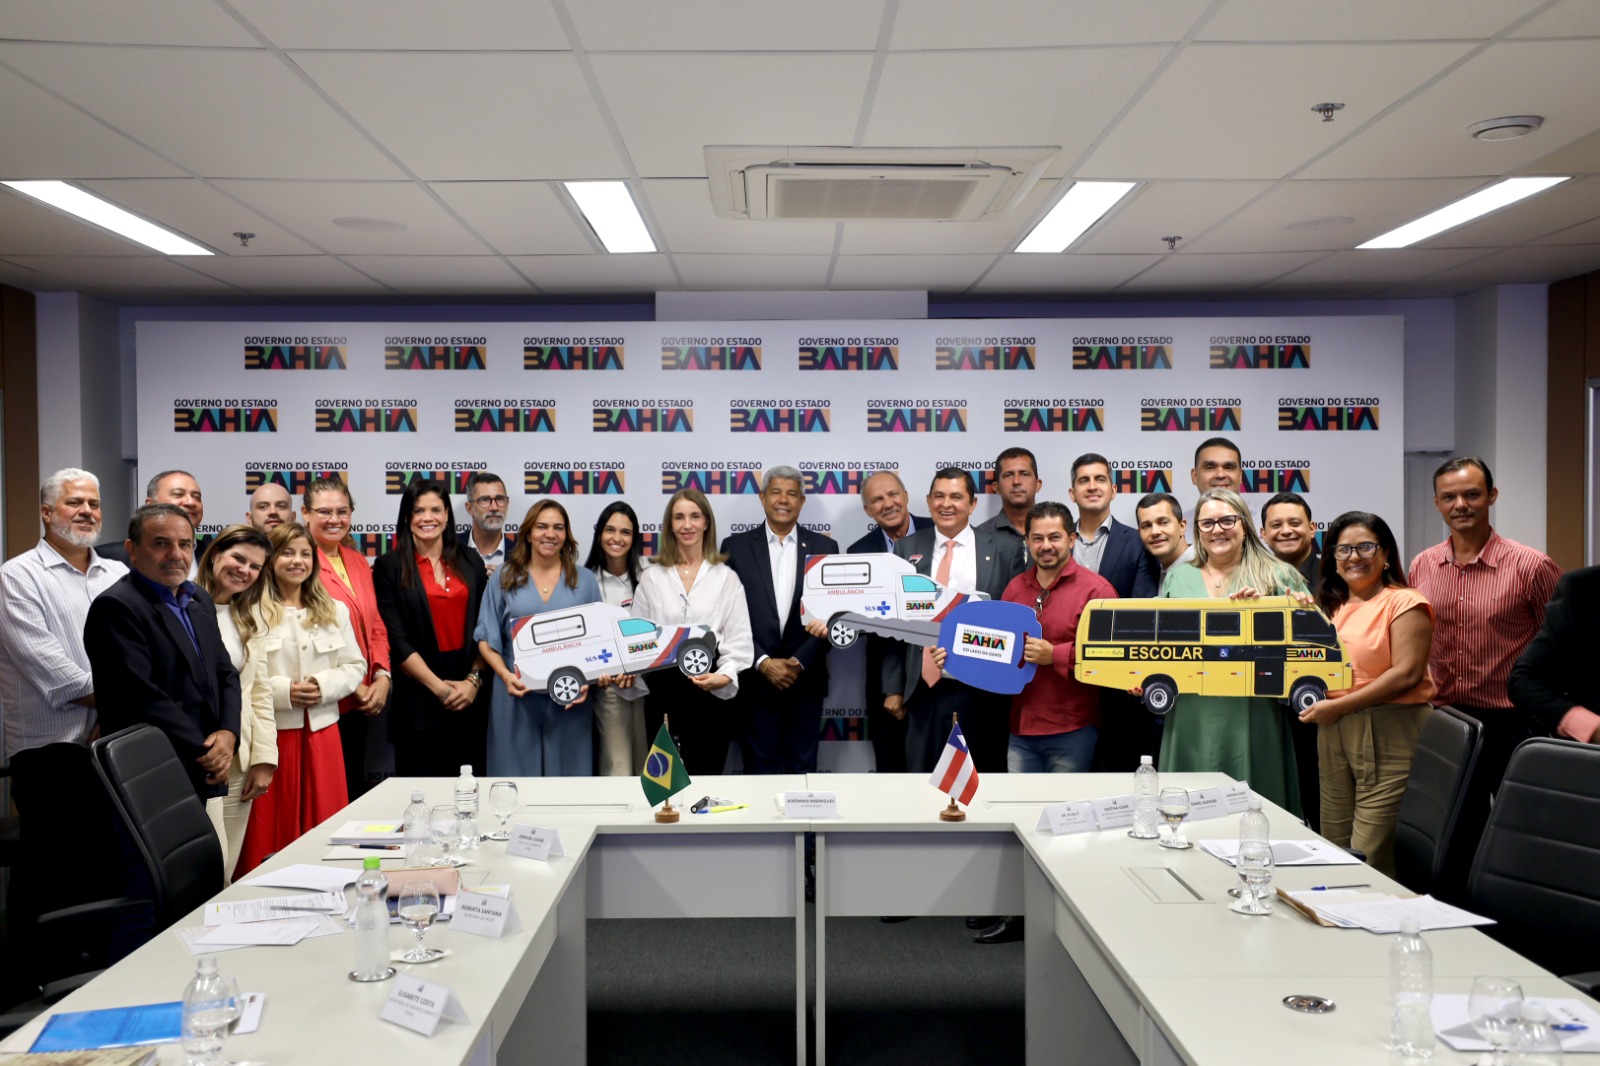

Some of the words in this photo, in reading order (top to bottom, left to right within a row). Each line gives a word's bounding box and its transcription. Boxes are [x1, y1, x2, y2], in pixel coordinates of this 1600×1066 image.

[244, 336, 293, 345] GOVERNO
[295, 336, 309, 345] DO
[311, 336, 347, 345] ESTADO
[384, 336, 433, 345] GOVERNO
[434, 336, 449, 345] DO
[450, 336, 487, 345] ESTADO
[523, 337, 571, 345] GOVERNO
[572, 337, 587, 345] DO
[589, 337, 625, 345] ESTADO
[661, 337, 708, 346] GOVERNO
[711, 337, 725, 346] DO
[727, 337, 762, 346] ESTADO
[798, 337, 846, 346] GOVERNO
[848, 337, 862, 346] DO
[864, 337, 899, 346] ESTADO
[935, 337, 982, 346] GOVERNO
[985, 337, 999, 346] DO
[1001, 337, 1036, 346] ESTADO
[1072, 336, 1119, 345] GOVERNO
[1121, 336, 1135, 345] DO
[1137, 336, 1173, 345] ESTADO
[1209, 335, 1256, 344] GOVERNO
[1258, 335, 1273, 344] DO
[1275, 335, 1311, 344] ESTADO
[244, 346, 347, 370] BAHIA
[384, 346, 487, 370] BAHIA
[523, 347, 625, 370] BAHIA
[661, 347, 762, 370] BAHIA
[798, 347, 899, 370] BAHIA
[935, 347, 1036, 370] BAHIA
[1072, 346, 1173, 370] BAHIA
[1209, 345, 1311, 369] BAHIA
[174, 399, 223, 408] GOVERNO
[225, 399, 239, 408] DO
[241, 399, 278, 408] ESTADO
[315, 399, 363, 408] GOVERNO
[365, 399, 379, 408] DO
[381, 399, 418, 408] ESTADO
[454, 399, 502, 408] GOVERNO
[503, 399, 518, 408] DO
[520, 399, 556, 408] ESTADO
[592, 399, 640, 408] GOVERNO
[642, 399, 656, 408] DO
[658, 399, 694, 408] ESTADO
[729, 399, 777, 408] GOVERNO
[779, 399, 793, 408] DO
[795, 399, 831, 408] ESTADO
[866, 399, 914, 408] GOVERNO
[916, 399, 930, 408] DO
[932, 399, 968, 408] ESTADO
[1003, 399, 1051, 408] GOVERNO
[1053, 399, 1067, 408] DO
[1069, 399, 1105, 408] ESTADO
[1140, 398, 1188, 407] GOVERNO
[1190, 398, 1204, 407] DO
[1206, 398, 1242, 407] ESTADO
[1278, 398, 1326, 407] GOVERNO
[1327, 398, 1342, 407] DO
[1343, 398, 1380, 407] ESTADO
[174, 408, 278, 432] BAHIA
[315, 408, 418, 432] BAHIA
[454, 408, 556, 432] BAHIA
[592, 408, 694, 432] BAHIA
[729, 408, 831, 432] BAHIA
[866, 408, 968, 432] BAHIA
[1003, 408, 1105, 432] BAHIA
[1140, 408, 1242, 431] BAHIA
[1278, 407, 1380, 431] BAHIA
[244, 461, 294, 470] GOVERNO
[295, 461, 310, 470] DO
[312, 461, 348, 470] ESTADO
[385, 461, 433, 470] GOVERNO
[435, 461, 449, 470] DO
[451, 461, 487, 470] ESTADO
[523, 461, 571, 470] GOVERNO
[573, 461, 587, 470] DO
[589, 461, 625, 470] ESTADO
[661, 461, 709, 470] GOVERNO
[710, 461, 725, 470] DO
[726, 461, 762, 470] ESTADO
[798, 461, 846, 470] GOVERNO
[847, 461, 862, 470] DO
[863, 461, 899, 470] ESTADO
[1121, 461, 1135, 469] DO
[1137, 461, 1173, 469] ESTADO
[1258, 460, 1273, 468] DO
[1274, 460, 1310, 468] ESTADO
[524, 471, 625, 494] BAHIA
[366, 523, 380, 532] DO
[504, 523, 519, 532] DO
[642, 523, 656, 532] DO
[906, 602, 935, 611] BAHIA
[962, 632, 1007, 651] BAHIA
[541, 641, 582, 654] AMBULÂNCIA
[628, 641, 658, 654] BAHIA
[1129, 646, 1204, 660] ESCOLAR
[585, 655, 598, 663] SUS
[848, 708, 862, 716] DO
